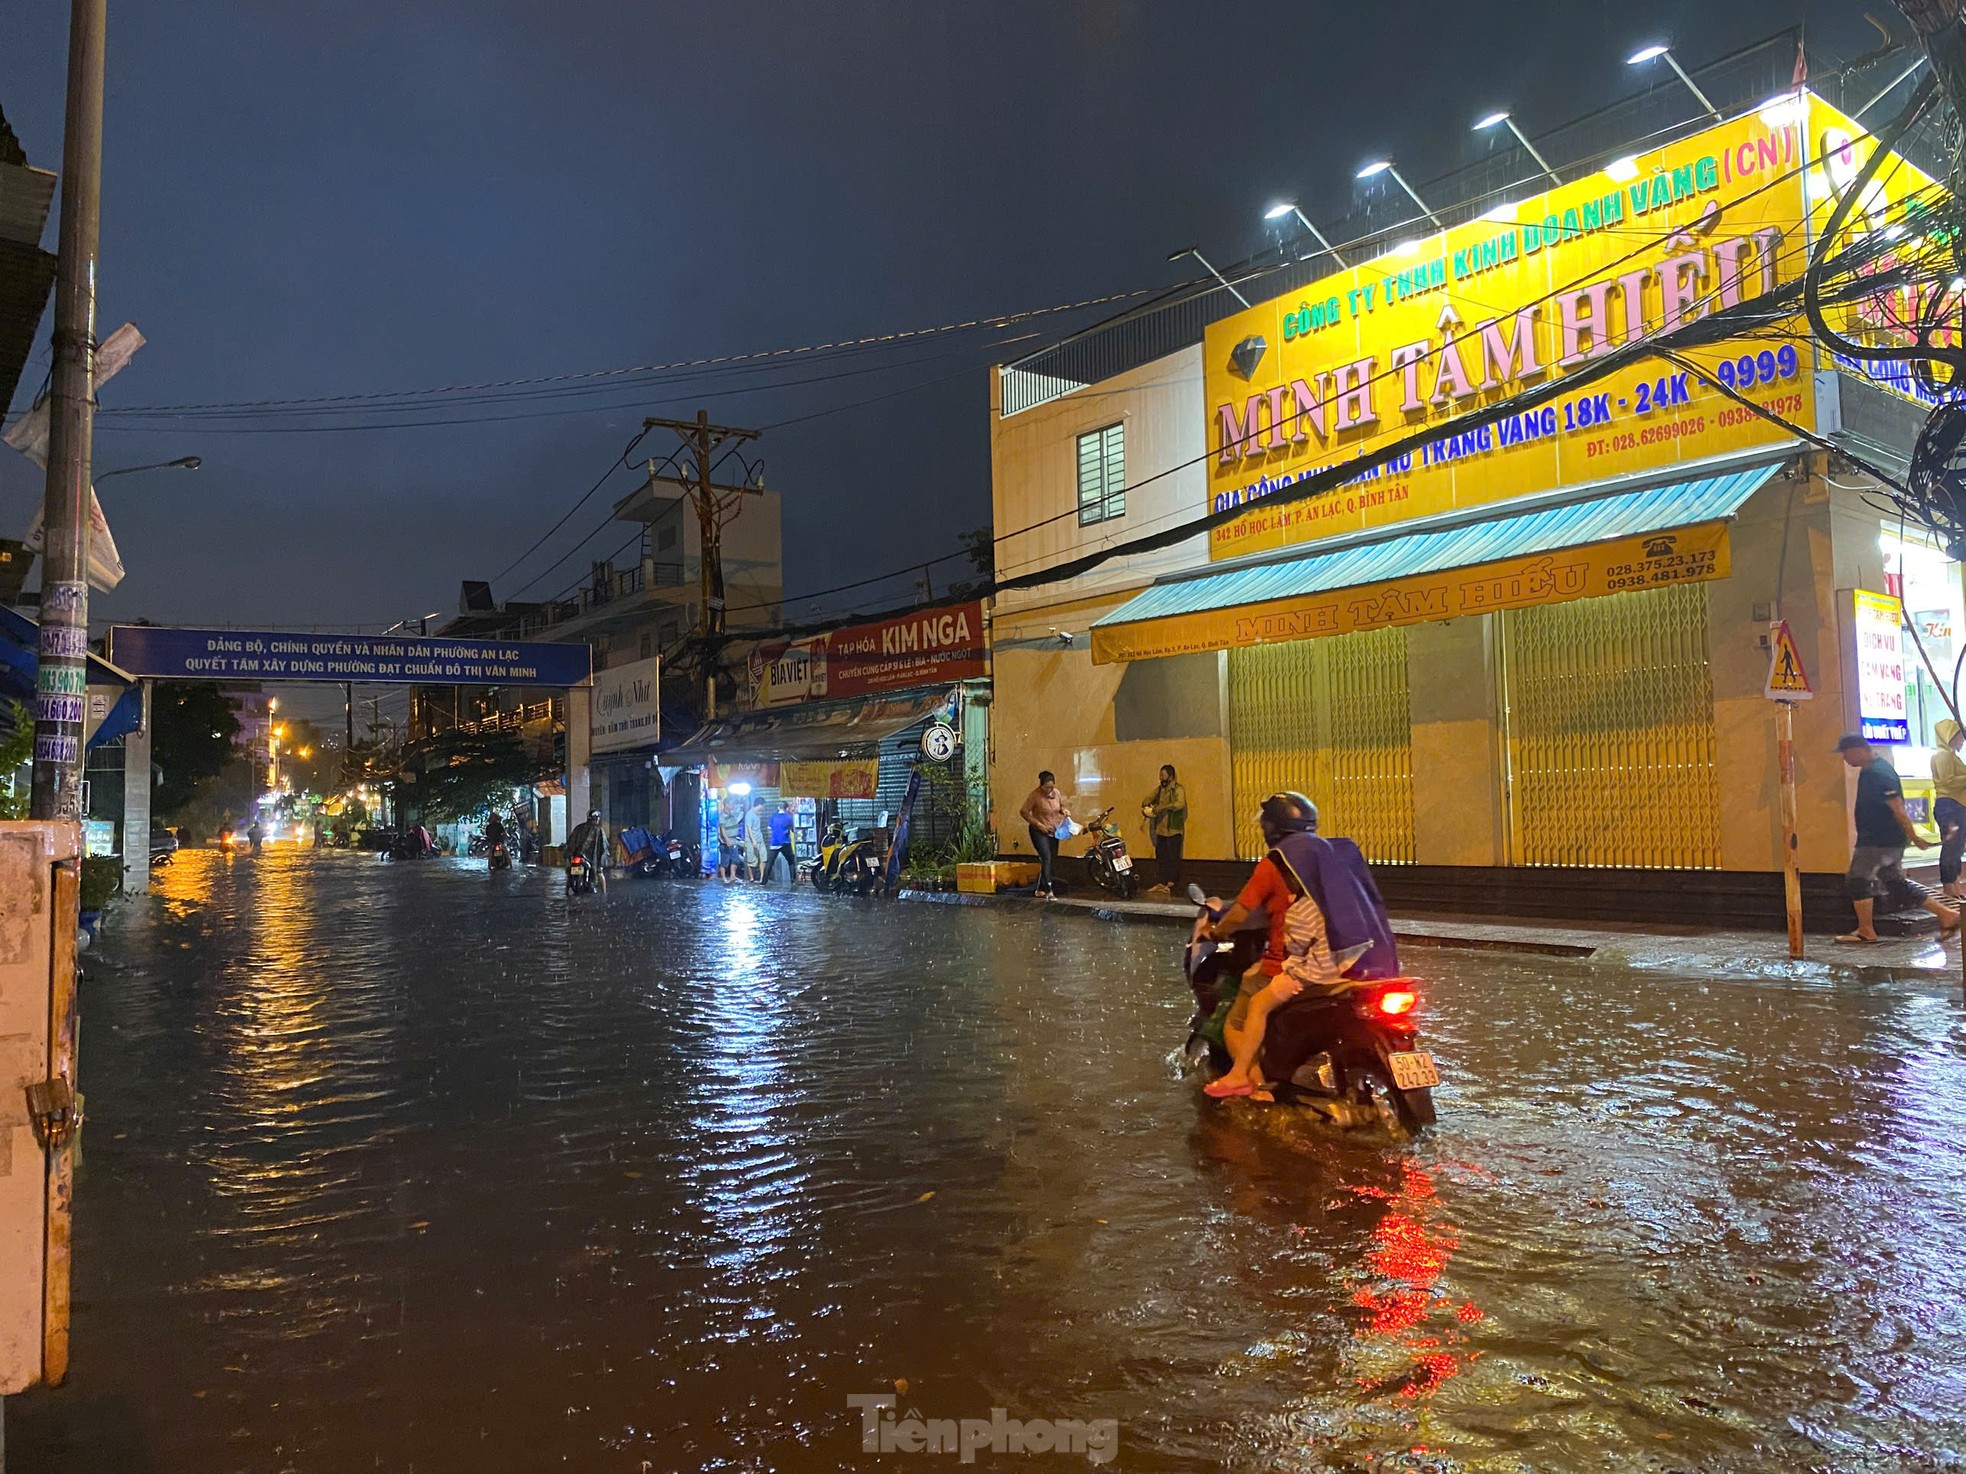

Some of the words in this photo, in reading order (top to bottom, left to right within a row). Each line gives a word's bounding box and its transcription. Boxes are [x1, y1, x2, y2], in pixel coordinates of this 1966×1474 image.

[1284, 301, 1341, 340] CÔNG
[1347, 283, 1377, 317] TY
[1382, 257, 1447, 305] TNHH
[1453, 229, 1518, 280] KINH
[1523, 190, 1625, 254] DOANH
[1628, 155, 1719, 217] VÀNG
[1723, 126, 1792, 183] (CN)
[1218, 356, 1378, 463] MINH
[1392, 304, 1541, 414] TÂM
[1556, 200, 1784, 367] HIẾU
[1564, 392, 1612, 431] 18K
[1634, 371, 1691, 414] 24K
[1717, 344, 1799, 392] 9999
[1586, 440, 1610, 458] ĐT:
[1612, 416, 1706, 452] 028.62699026
[1718, 393, 1803, 428] 09381978
[1216, 526, 1231, 542] 342
[1296, 510, 1304, 525] P.
[1306, 505, 1319, 522] AN
[1322, 500, 1345, 519] LẠC,
[1347, 498, 1358, 514] Q.
[1359, 491, 1385, 510] BÌNH
[1388, 483, 1409, 502] TÂN
[1606, 549, 1716, 577] 028.375.23.173
[1607, 564, 1716, 591] 0938.481.978
[1236, 604, 1338, 642] MINH
[1347, 588, 1447, 627] TÂM
[1460, 556, 1590, 610] HIẾU
[207, 636, 242, 652] ĐẢNG
[245, 639, 267, 655] BỘ,
[270, 639, 308, 654] CHÍNH
[312, 640, 351, 656] QUYỀN
[354, 642, 370, 656] VÀ
[373, 644, 404, 657] NHÂN
[407, 645, 431, 658] DÂN
[433, 645, 479, 660] PHƯỜNG
[481, 649, 496, 660] AN
[498, 649, 519, 663] LẠC
[882, 622, 918, 656] KIM
[923, 611, 971, 649] NGA
[185, 655, 227, 672] QUYẾT
[231, 658, 259, 671] TÂM
[263, 658, 288, 672] XÂY
[291, 659, 324, 675] DỰNG
[327, 659, 375, 674] PHƯỜNG
[378, 662, 401, 677] ĐẠT
[405, 659, 443, 676] CHUẨN
[445, 662, 461, 676] ĐÔ
[463, 664, 482, 679] THỊ
[485, 664, 506, 678] VĂN
[509, 666, 537, 679] MINH
